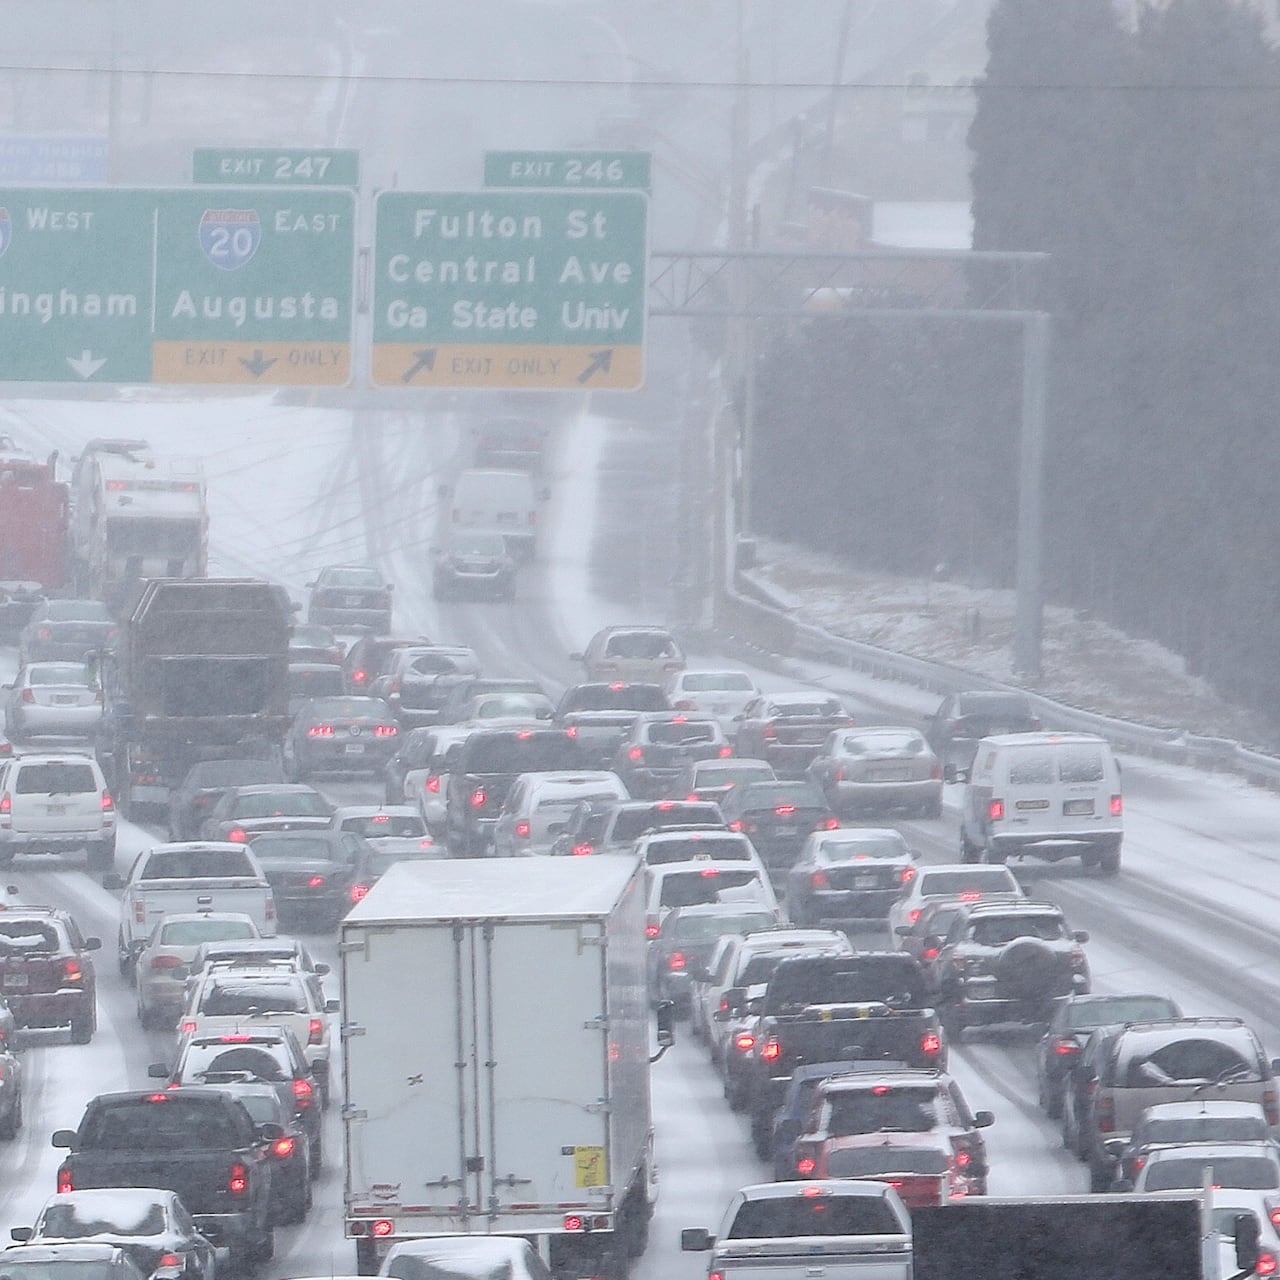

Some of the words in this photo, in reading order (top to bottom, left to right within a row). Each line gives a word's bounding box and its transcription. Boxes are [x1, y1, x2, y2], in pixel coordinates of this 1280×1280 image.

[220, 159, 264, 176] EXIT
[274, 158, 332, 178] 247
[510, 161, 555, 180] EXIT
[565, 160, 624, 181] 246
[27, 207, 96, 231] WEST
[414, 209, 542, 238] Fulton
[567, 209, 607, 239] St
[209, 228, 253, 258] 20
[275, 209, 340, 233] EAST
[388, 254, 536, 283] Central
[559, 255, 633, 284] Ave
[171, 290, 339, 327] Augusta
[386, 300, 428, 329] Ga
[452, 300, 539, 329] State
[561, 301, 630, 330] Univ
[184, 349, 228, 367] EXIT
[288, 349, 341, 366] ONLY
[451, 357, 494, 376] EXIT
[507, 357, 561, 376] ONLY
